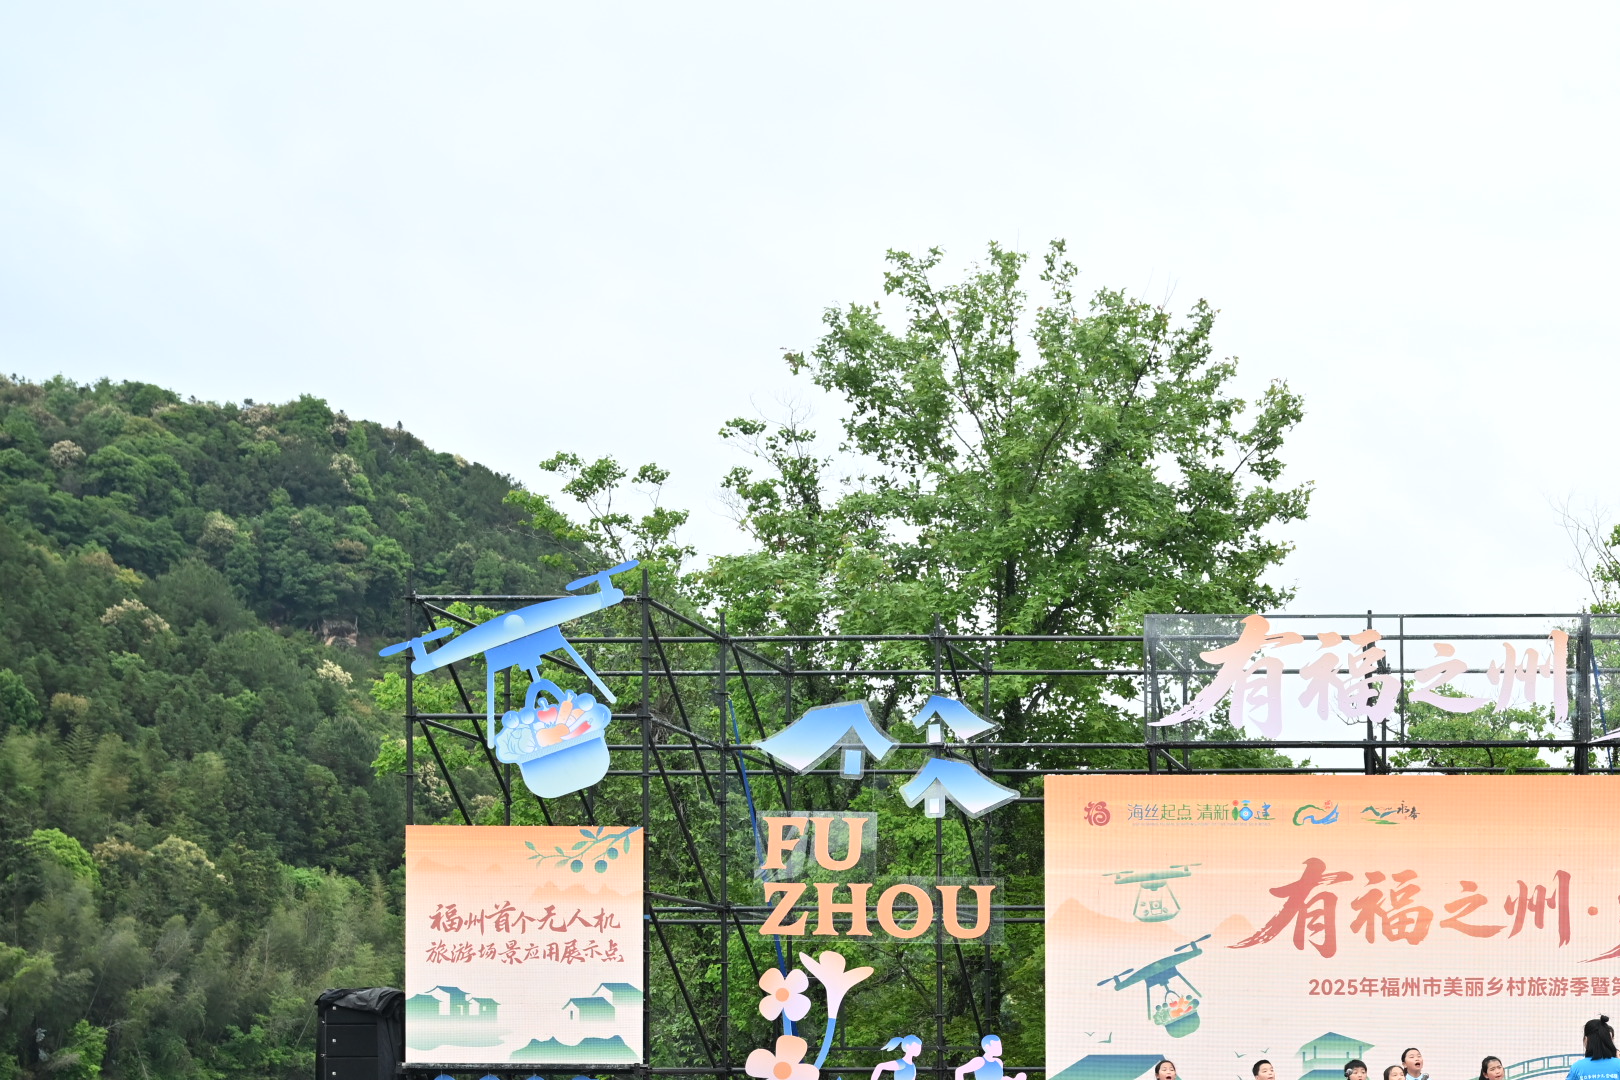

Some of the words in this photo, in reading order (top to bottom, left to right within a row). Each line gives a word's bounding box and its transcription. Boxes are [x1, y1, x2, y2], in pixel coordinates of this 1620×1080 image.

[1146, 612, 1570, 738] 有福之州
[1127, 803, 1193, 821] 海丝起点
[759, 816, 864, 871] FU
[428, 900, 621, 936] 福州首个无人机
[757, 882, 996, 939] ZHOU
[425, 938, 624, 965] 旅游场景应用展示点
